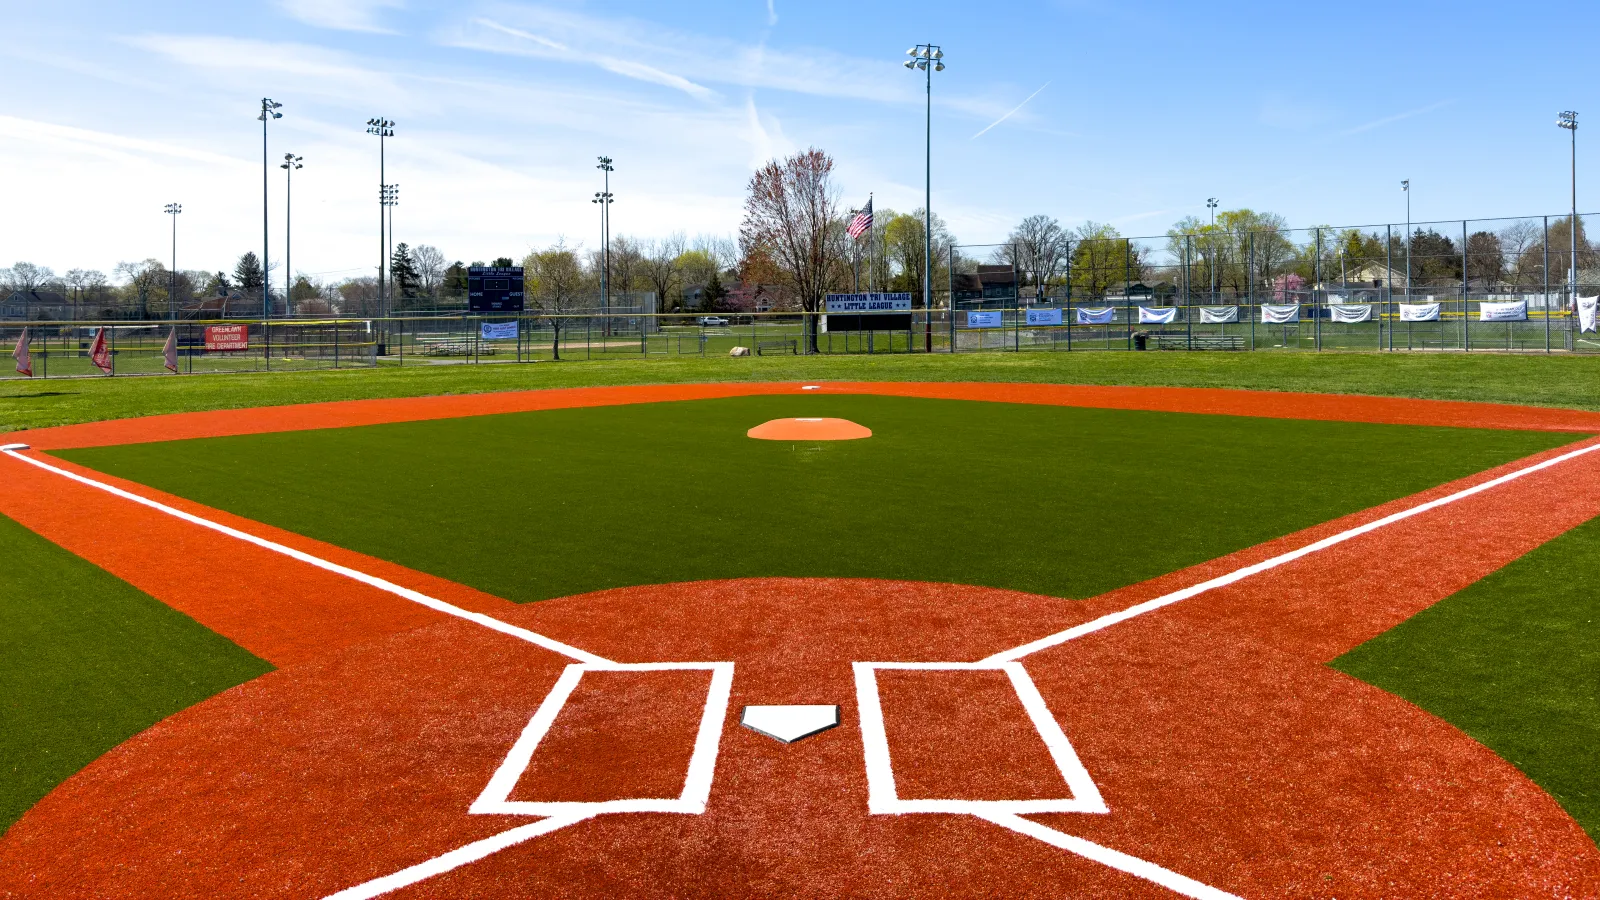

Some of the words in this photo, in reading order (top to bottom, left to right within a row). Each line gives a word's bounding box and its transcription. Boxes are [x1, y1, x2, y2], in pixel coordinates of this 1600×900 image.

[826, 294, 867, 302] HUNTINGTON
[870, 293, 881, 301] TRI
[884, 293, 910, 301] VILLAGE
[844, 302, 866, 310] LITTLE
[869, 302, 893, 310] LEAGUE
[205, 342, 216, 350] FIRE
[216, 342, 248, 350] DEPARTMENT
